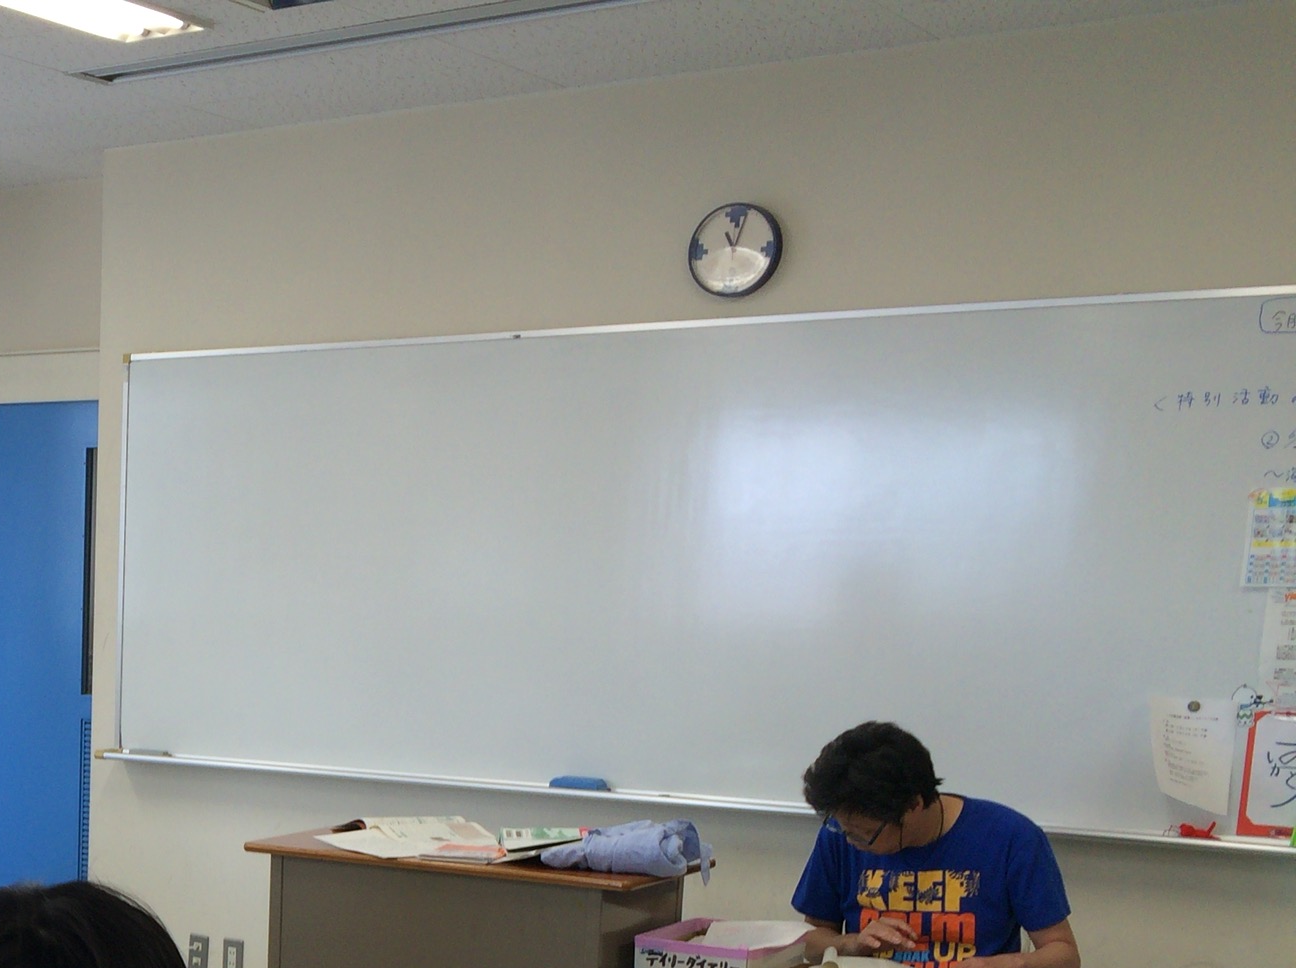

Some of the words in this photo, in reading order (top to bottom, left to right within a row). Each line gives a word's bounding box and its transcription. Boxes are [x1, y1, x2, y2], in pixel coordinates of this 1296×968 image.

[857, 869, 980, 913] KEEP
[860, 907, 976, 952] CLM
[933, 941, 977, 963] UP
